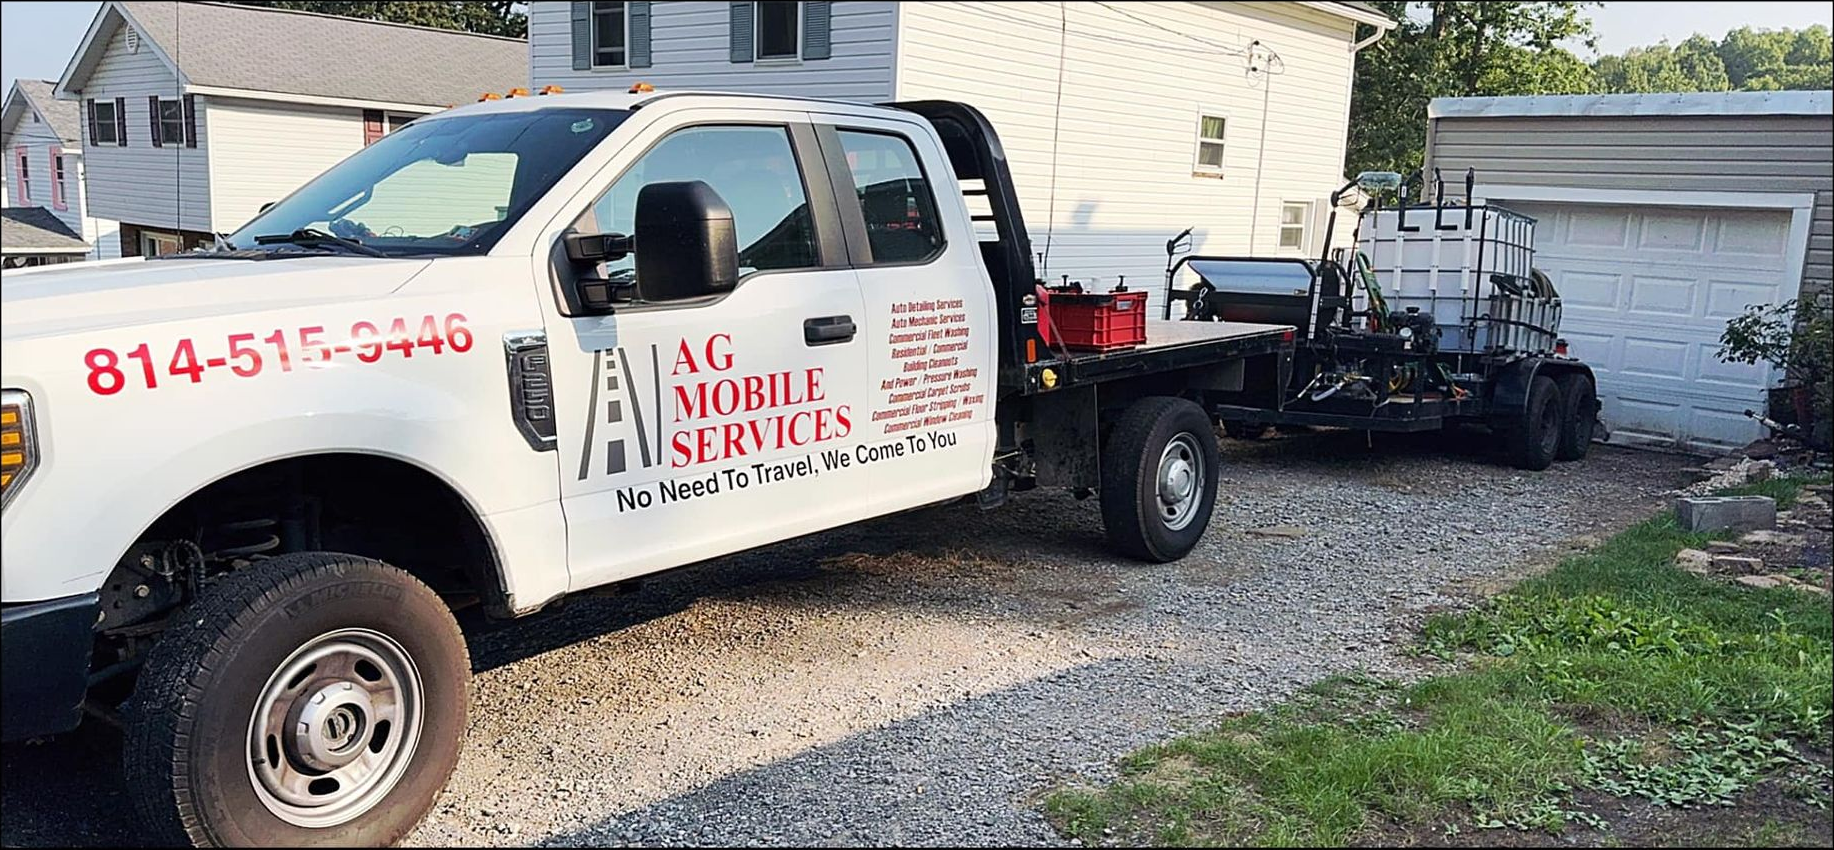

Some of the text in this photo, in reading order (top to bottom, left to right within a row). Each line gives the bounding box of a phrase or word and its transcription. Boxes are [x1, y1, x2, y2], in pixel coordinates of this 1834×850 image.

[892, 300, 962, 313] Auto Detailing Services
[892, 314, 965, 328] Auto Mechanic Services
[889, 328, 969, 344] Commercial Fleet Washing
[84, 313, 473, 396] 814-515-9446
[892, 346, 927, 359] Residential
[933, 342, 968, 353] Commercial
[903, 357, 958, 372] Building Cleanouts
[881, 380, 894, 390] And
[895, 377, 917, 388] Power
[923, 372, 952, 384] Pressure
[953, 368, 977, 379] Washing
[672, 368, 825, 422] MOBILE
[889, 383, 970, 404] Commercial Carpet Scrubs
[872, 406, 911, 421] Commercial
[912, 404, 928, 414] Floor
[929, 400, 957, 411] Stripping
[963, 395, 983, 405] Waxing
[884, 410, 972, 434] Commercial Window Cleaning
[671, 405, 851, 468] SERVICES
[616, 431, 956, 512] No Need To Travel, We Come To You
